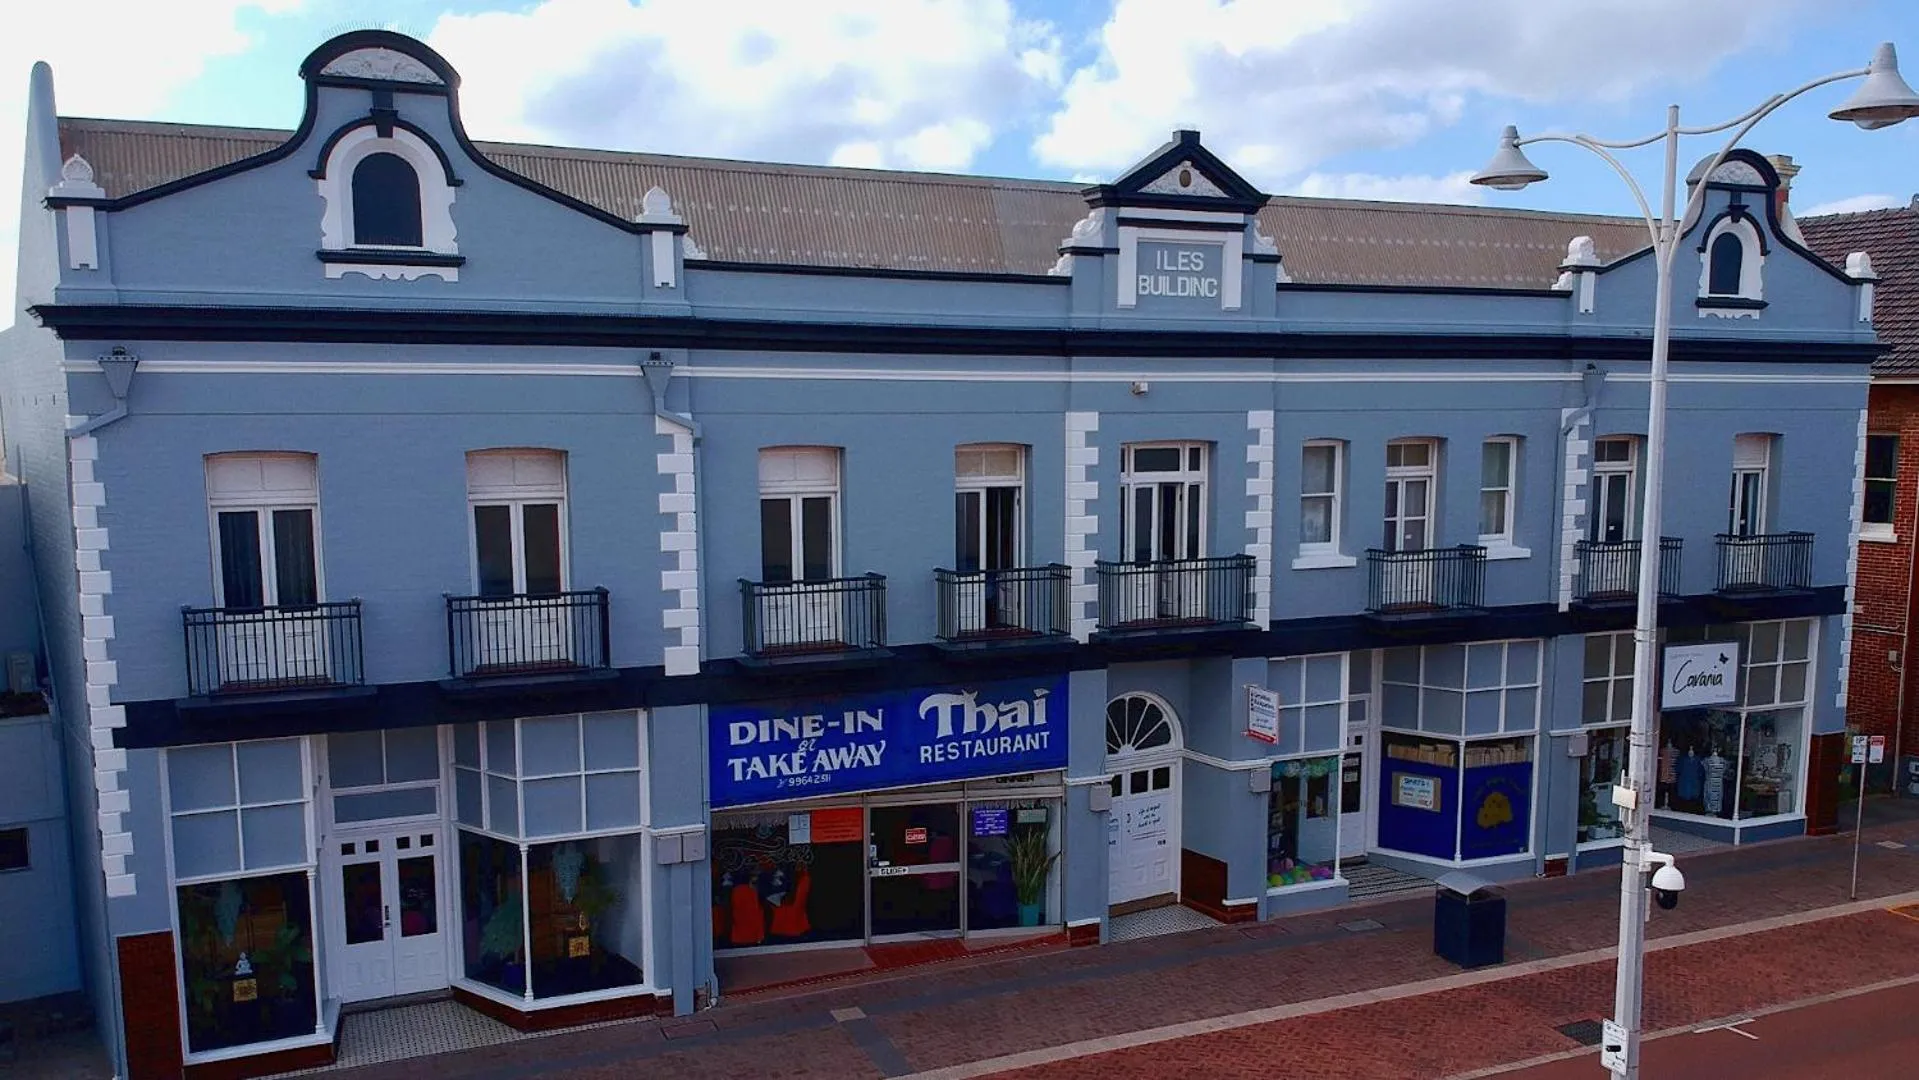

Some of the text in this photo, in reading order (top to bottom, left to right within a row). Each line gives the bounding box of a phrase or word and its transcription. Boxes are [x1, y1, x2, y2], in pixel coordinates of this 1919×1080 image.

[1156, 250, 1204, 271] ILES
[729, 708, 883, 745] DINE-IN
[919, 688, 1050, 739] Thai
[727, 740, 886, 782] TAKE AWAY
[920, 731, 1050, 763] RESTAURANT
